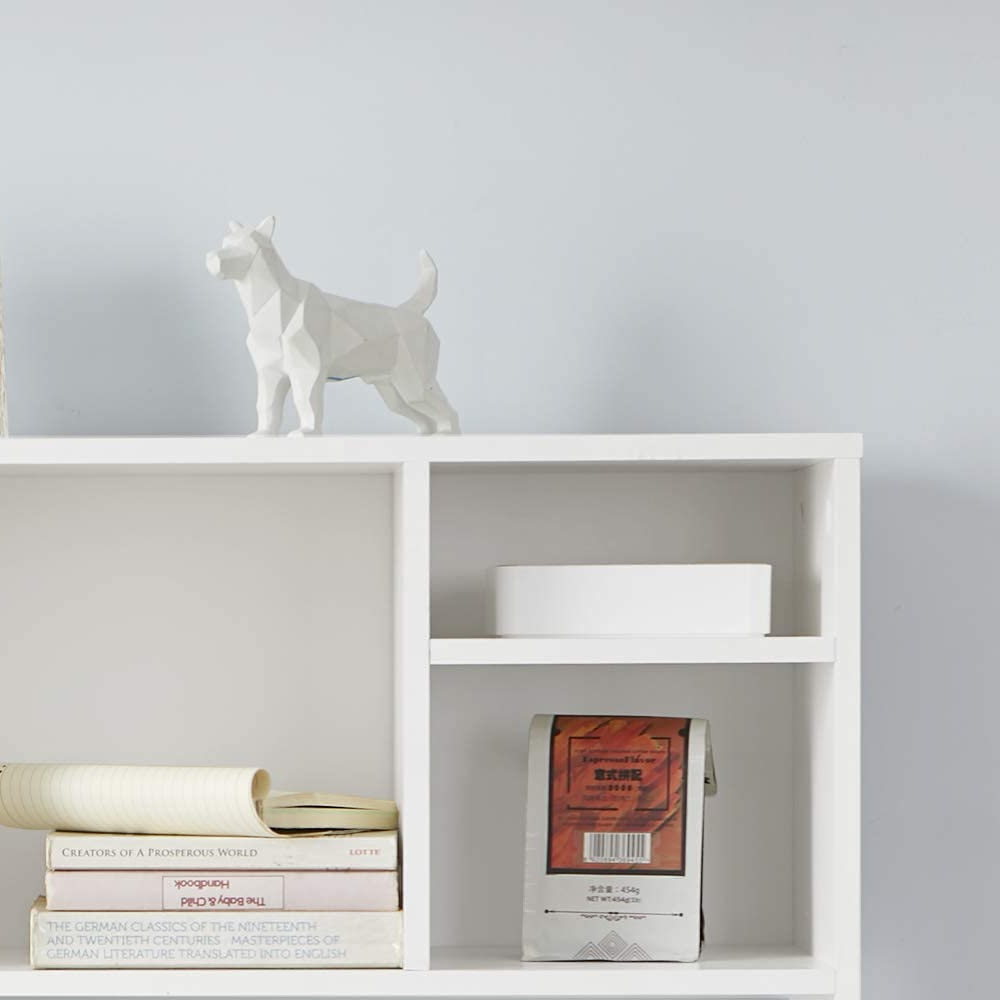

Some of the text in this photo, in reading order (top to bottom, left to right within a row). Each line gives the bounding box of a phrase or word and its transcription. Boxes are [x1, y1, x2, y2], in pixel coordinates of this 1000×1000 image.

[174, 879, 230, 890] Handbook
[180, 894, 266, 907] The Baby & Child
[47, 921, 318, 932] THE GERMAN CLASSICS OF THE NINETEENTH
[47, 935, 340, 946] AND TWENTIETH CENTURIES MASTERPIECES OF
[46, 949, 346, 960] GERMAN LITERATURE TRANSLATED INTO ENGLISH
